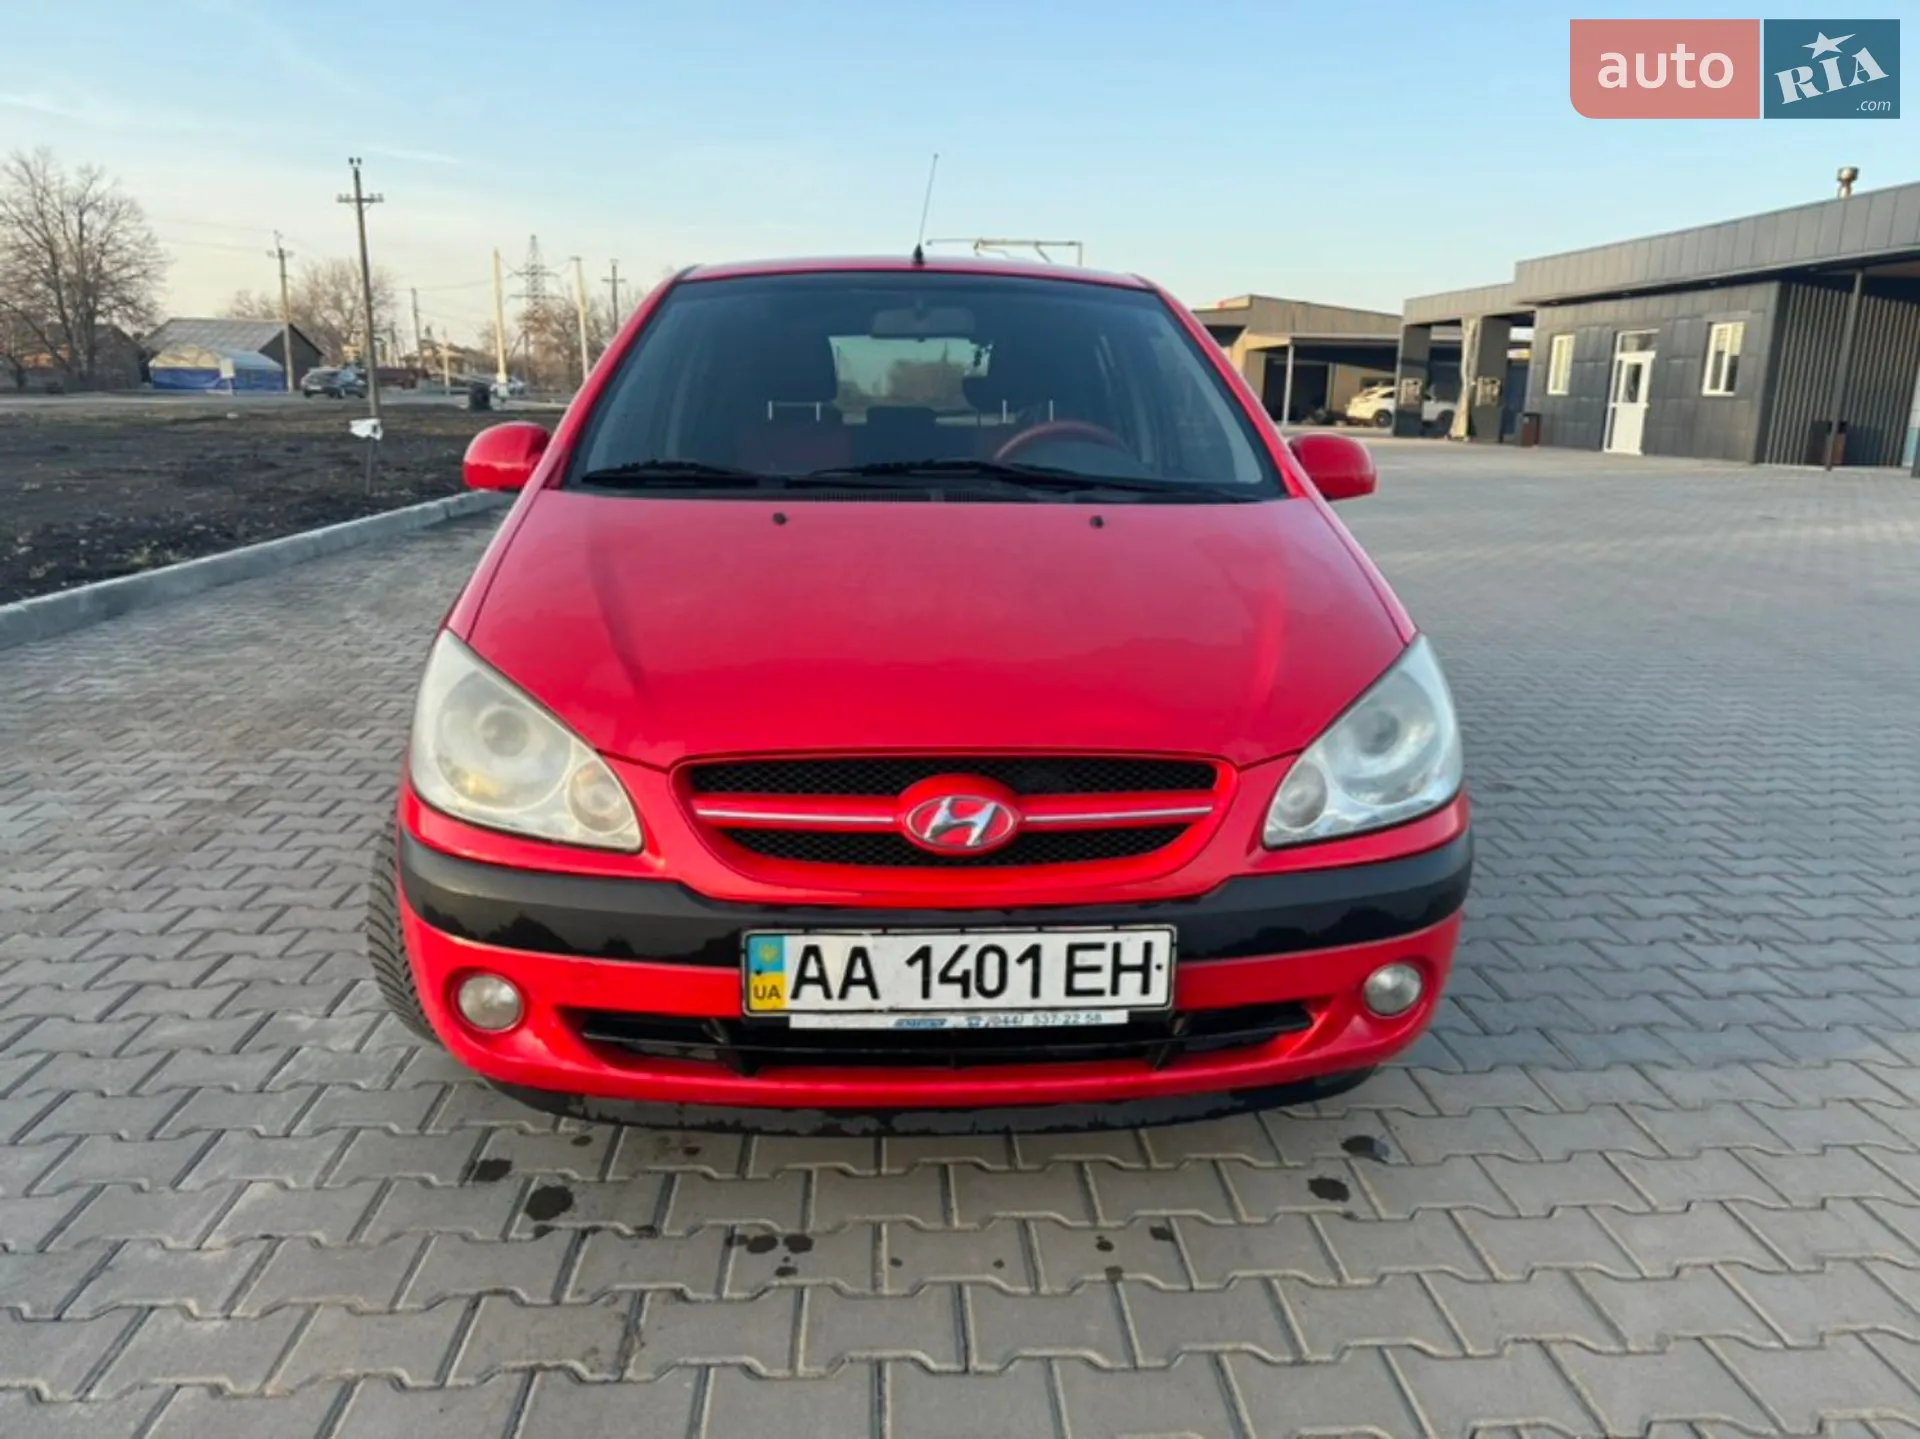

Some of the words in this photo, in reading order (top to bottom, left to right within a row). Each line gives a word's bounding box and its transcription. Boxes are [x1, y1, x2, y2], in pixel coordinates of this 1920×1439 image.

[789, 944, 880, 1001] AA
[905, 943, 1042, 1000] 1401
[1065, 941, 1153, 998] EH
[753, 984, 782, 1000] UA
